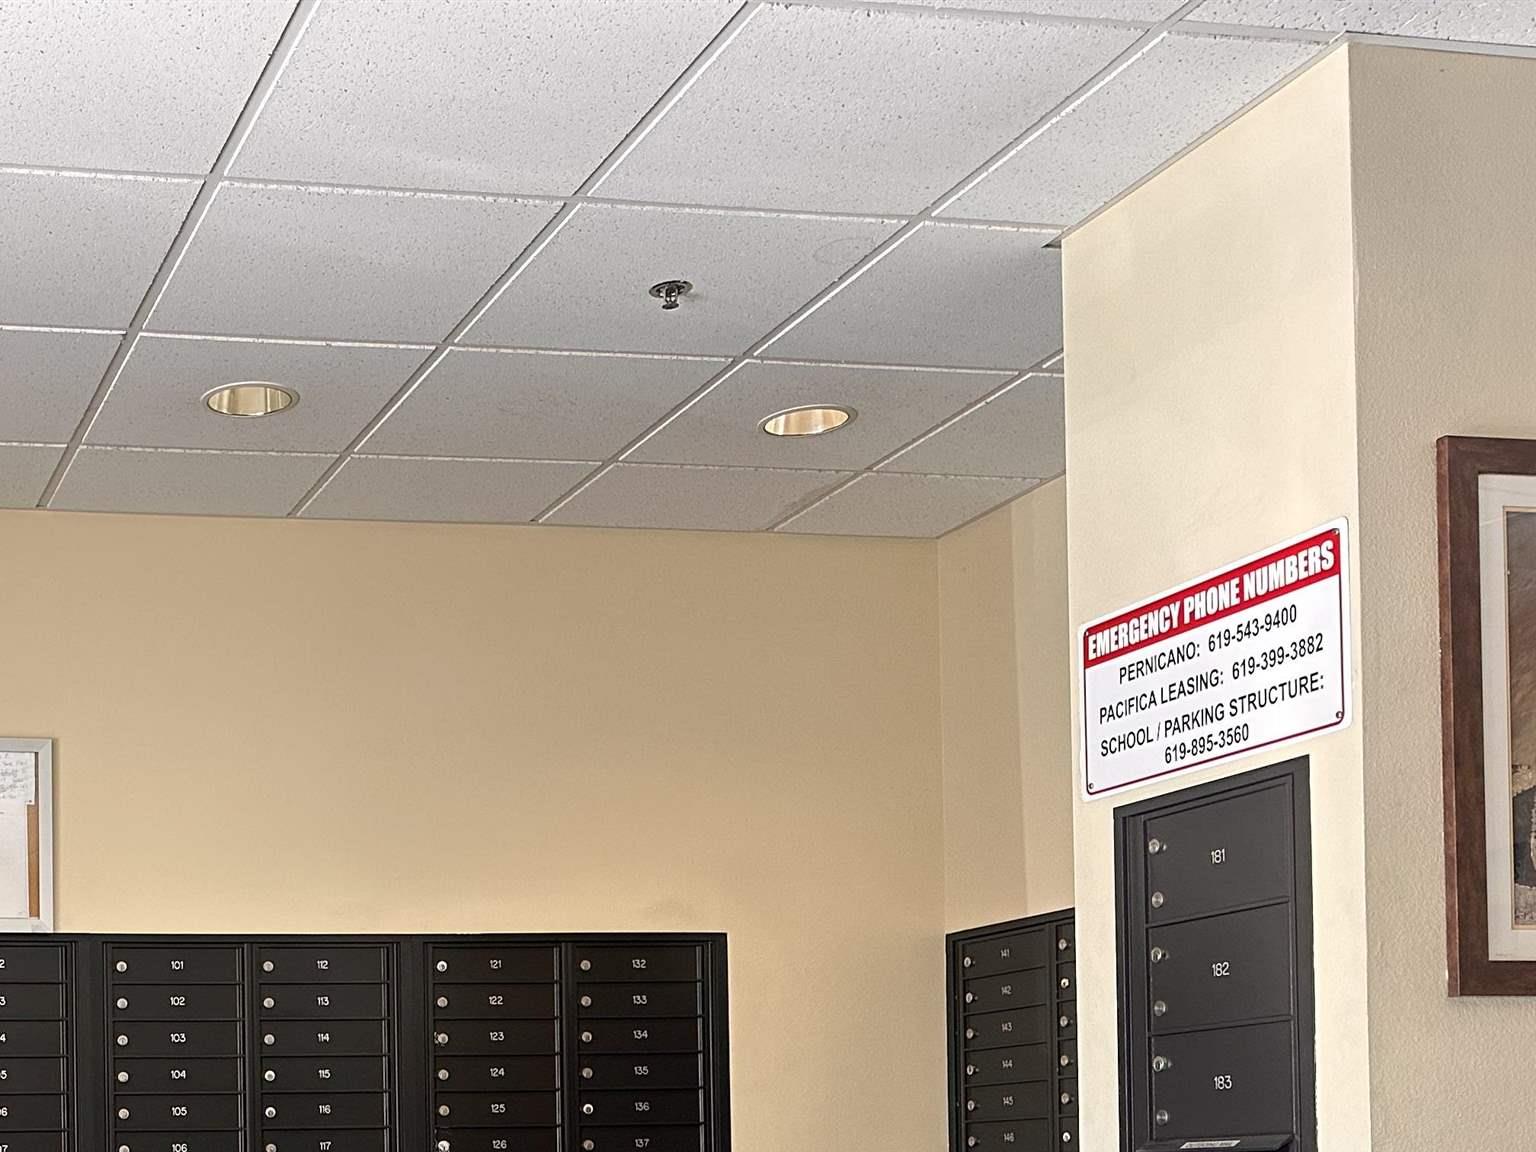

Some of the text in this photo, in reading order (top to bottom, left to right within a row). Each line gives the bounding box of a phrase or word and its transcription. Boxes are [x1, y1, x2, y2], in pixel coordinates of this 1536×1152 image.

[1088, 540, 1335, 661] EMERGENCY PHONE NUMBERS
[1119, 604, 1297, 684] PERNICANO: 619-543-9400
[1099, 633, 1324, 725] PACIFICA LEASING: 619-399-3882
[1100, 725, 1154, 757] SCHOOL
[1164, 703, 1225, 739] PARKING
[1229, 673, 1325, 717] STRUCTURE:
[1164, 723, 1250, 764] 619-895-3560
[1210, 848, 1226, 864] 181
[170, 960, 184, 970] 101
[316, 960, 329, 970] 112
[489, 959, 502, 969] 121
[631, 959, 647, 969] 132
[1211, 961, 1230, 977] 182
[170, 996, 186, 1006] 102
[317, 996, 330, 1006] 113
[488, 995, 504, 1006] 122
[632, 994, 648, 1005] 133
[170, 1033, 187, 1043] 103
[317, 1033, 330, 1042] 114
[489, 1031, 505, 1041] 123
[633, 1029, 649, 1040] 134
[170, 1069, 186, 1080] 104
[318, 1069, 331, 1079] 115
[489, 1067, 505, 1078] 124
[633, 1065, 649, 1076] 135
[1213, 1075, 1233, 1090] 183
[171, 1106, 188, 1117] 105
[318, 1104, 332, 1114] 116
[490, 1103, 506, 1114] 125
[634, 1101, 650, 1112] 136
[171, 1143, 188, 1152] 106
[319, 1141, 332, 1151] 117
[492, 1139, 507, 1150] 126
[634, 1138, 650, 1148] 137
